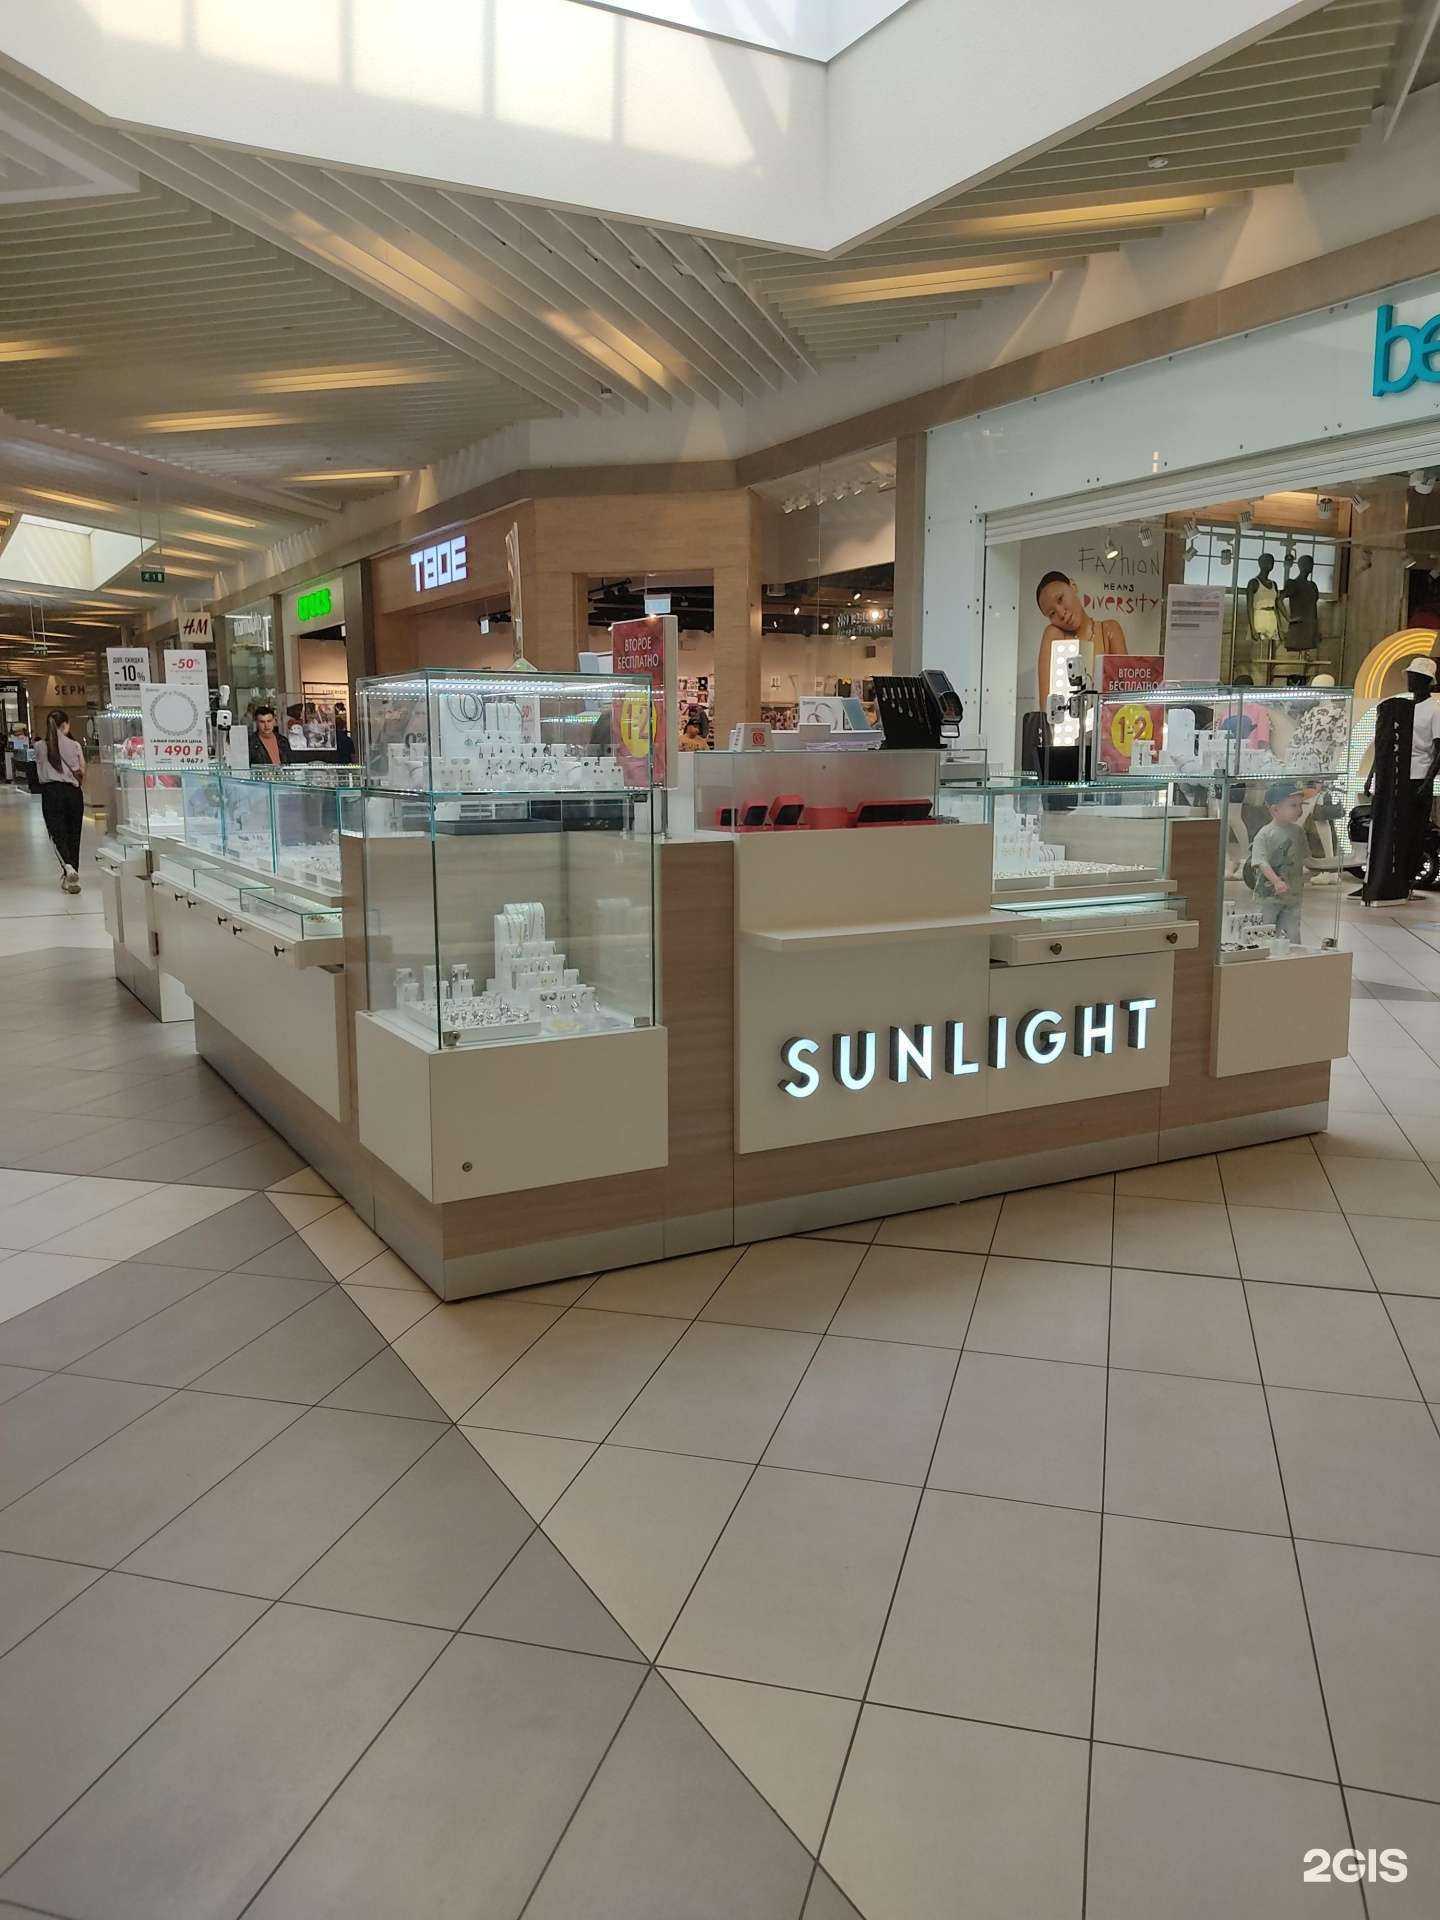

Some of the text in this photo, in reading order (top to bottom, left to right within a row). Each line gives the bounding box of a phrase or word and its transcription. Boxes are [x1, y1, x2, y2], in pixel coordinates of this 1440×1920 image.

[410, 535, 467, 592] ТВОЕ
[1104, 583, 1135, 592] MEANS
[624, 636, 652, 652] ВТОРОЕ
[617, 653, 659, 670] БЕСПЛАТНО
[1118, 667, 1152, 679] ВТОРОЕ
[1109, 680, 1159, 691] БЕСПЛАТНО
[164, 745, 191, 756] 490
[777, 997, 1157, 1099] SUNLIGHT
